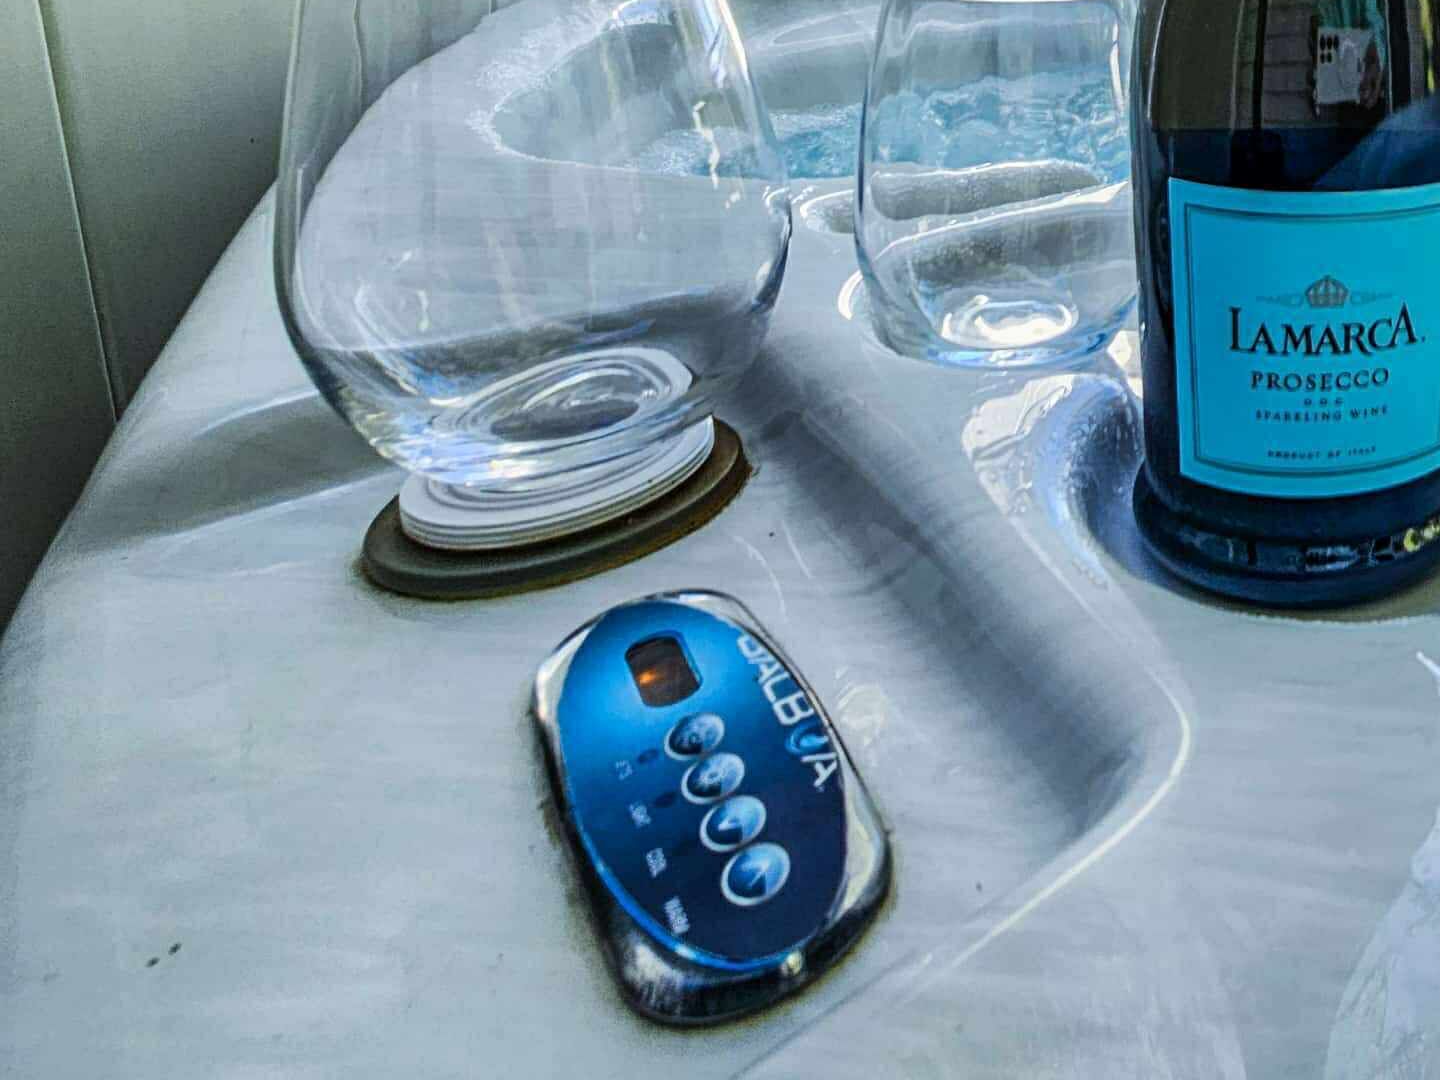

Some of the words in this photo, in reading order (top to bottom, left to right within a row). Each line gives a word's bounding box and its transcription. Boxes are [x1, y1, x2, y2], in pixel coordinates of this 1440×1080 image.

[1251, 368, 1390, 391] PROSECCO
[1256, 408, 1342, 421] SPARKLING
[1350, 404, 1388, 419] WINE
